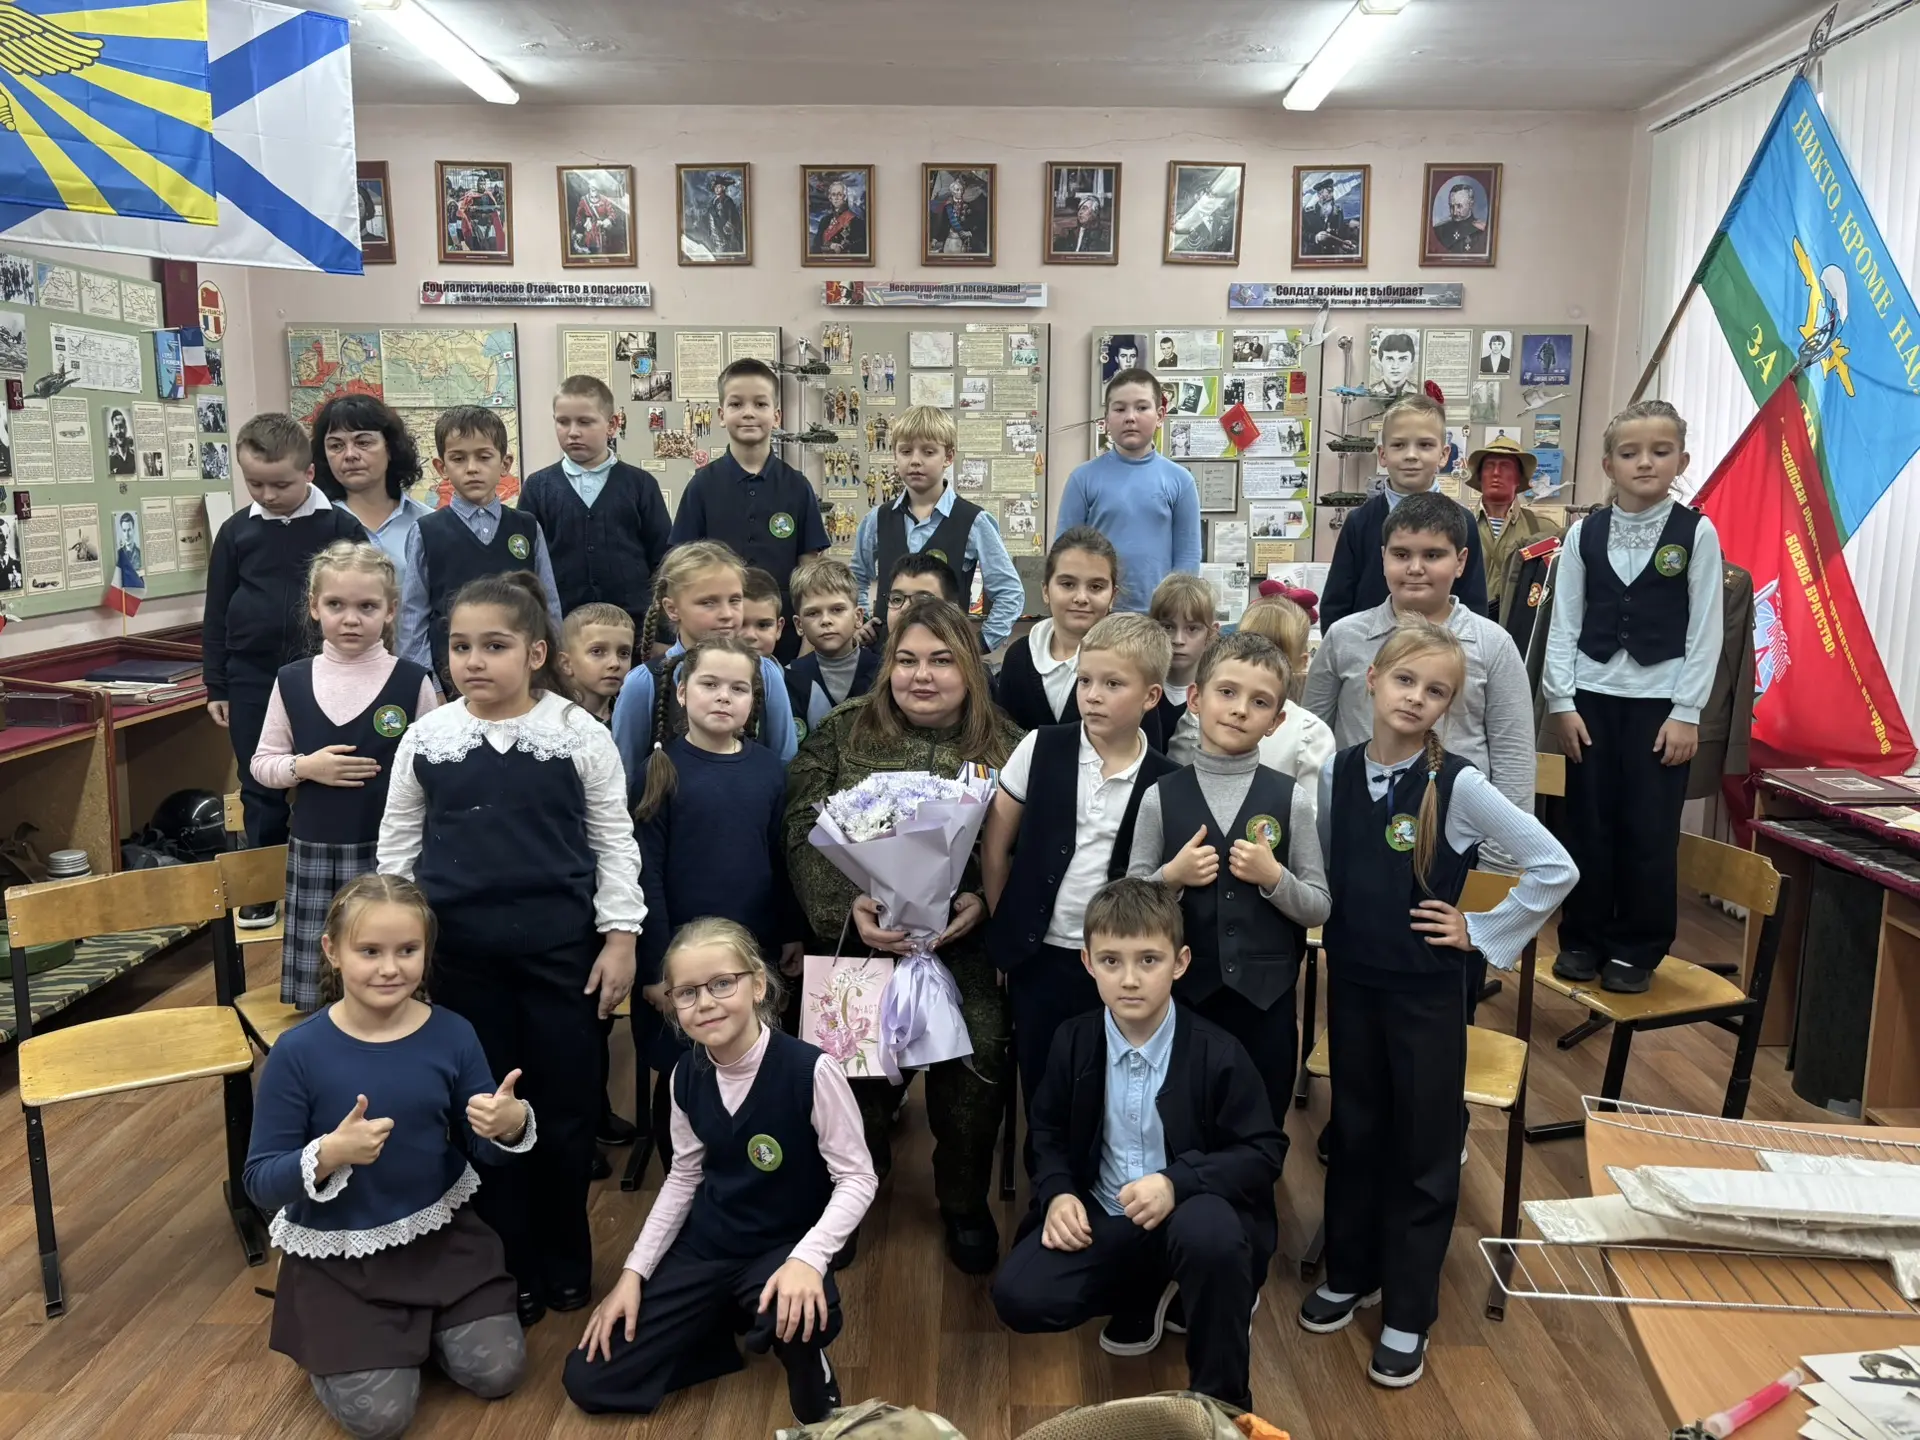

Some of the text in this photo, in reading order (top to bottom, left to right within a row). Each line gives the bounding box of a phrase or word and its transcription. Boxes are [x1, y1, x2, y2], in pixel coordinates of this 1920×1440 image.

[1792, 108, 1841, 223] НИКТО,
[1838, 209, 1894, 320] КРОМЕ
[422, 281, 647, 295] Социалистическое Отечество в опасности
[889, 283, 1021, 294] Несокрушимая и легендарная!
[1276, 284, 1424, 297] Солдат войны не выбирает
[1747, 322, 1778, 386] ЗА
[1784, 530, 1836, 659] «БОЕВОЕ БРАТСТВО»
[1861, 685, 1892, 755] ветеранов
